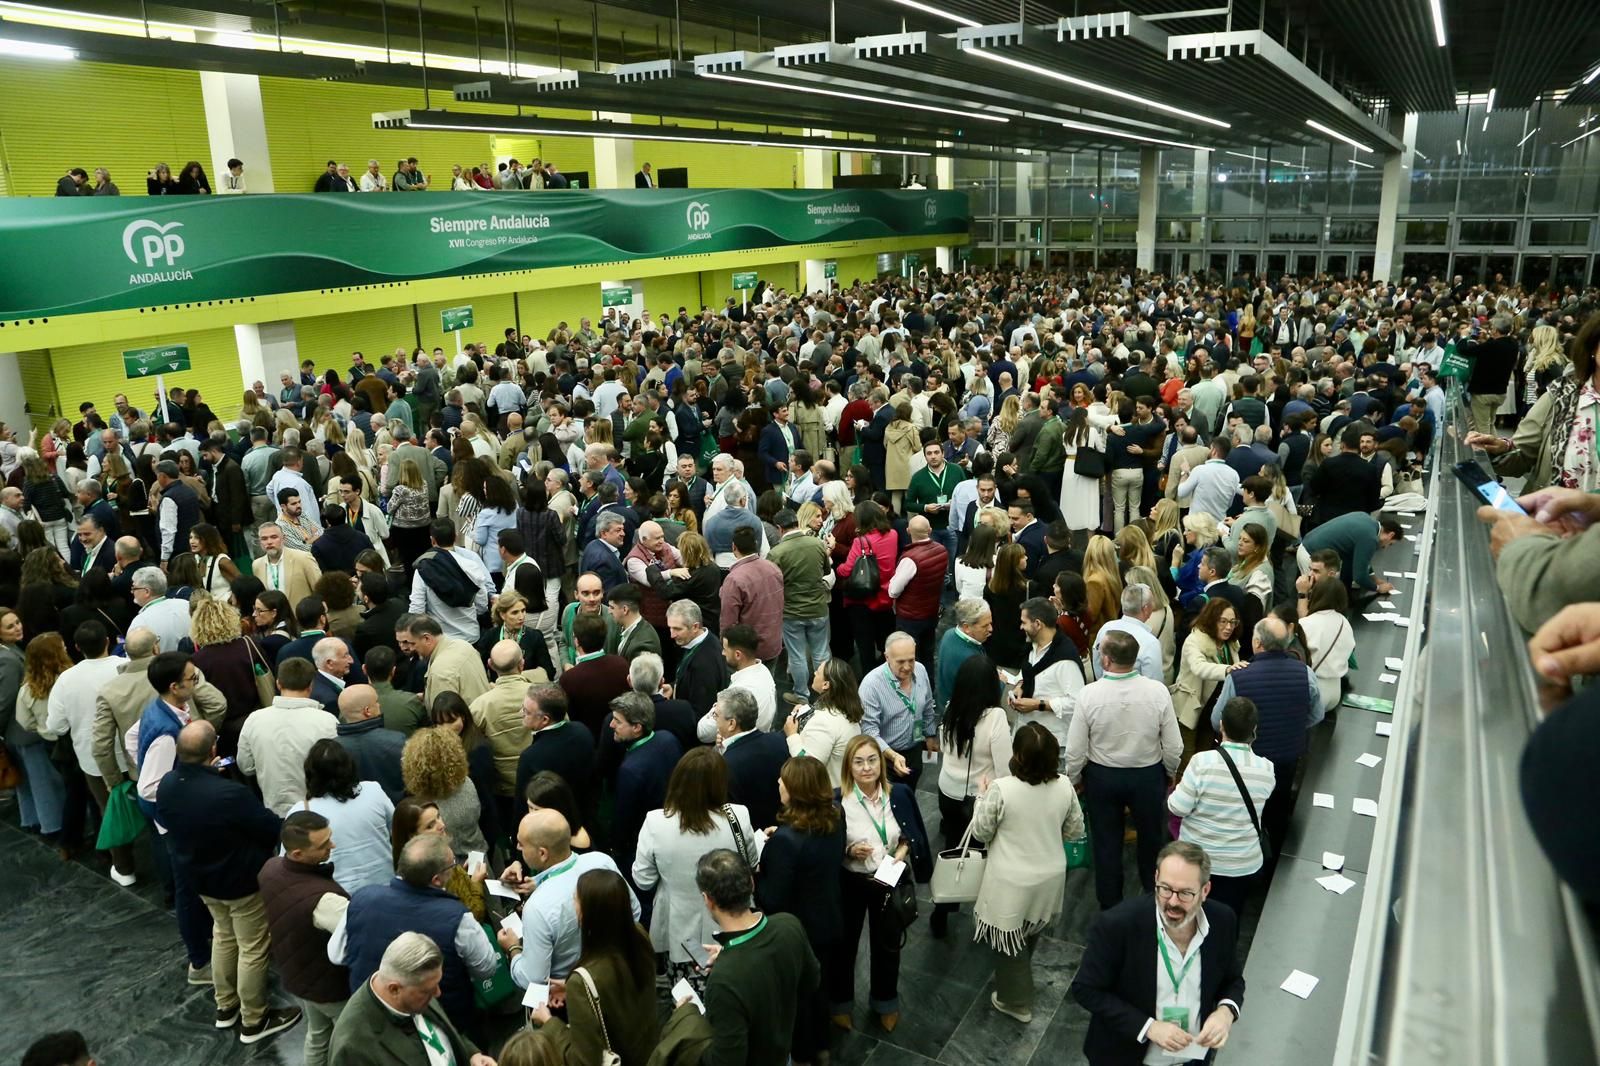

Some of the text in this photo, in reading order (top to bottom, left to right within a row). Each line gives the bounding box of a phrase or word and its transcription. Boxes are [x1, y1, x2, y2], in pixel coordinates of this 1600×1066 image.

[807, 203, 832, 216] Siempre
[430, 213, 550, 235] Siempre Andalucía
[449, 239, 465, 248] XVII
[465, 238, 497, 249] Congreso
[497, 236, 507, 245] PP
[129, 268, 193, 285] ANDALUCÍA
